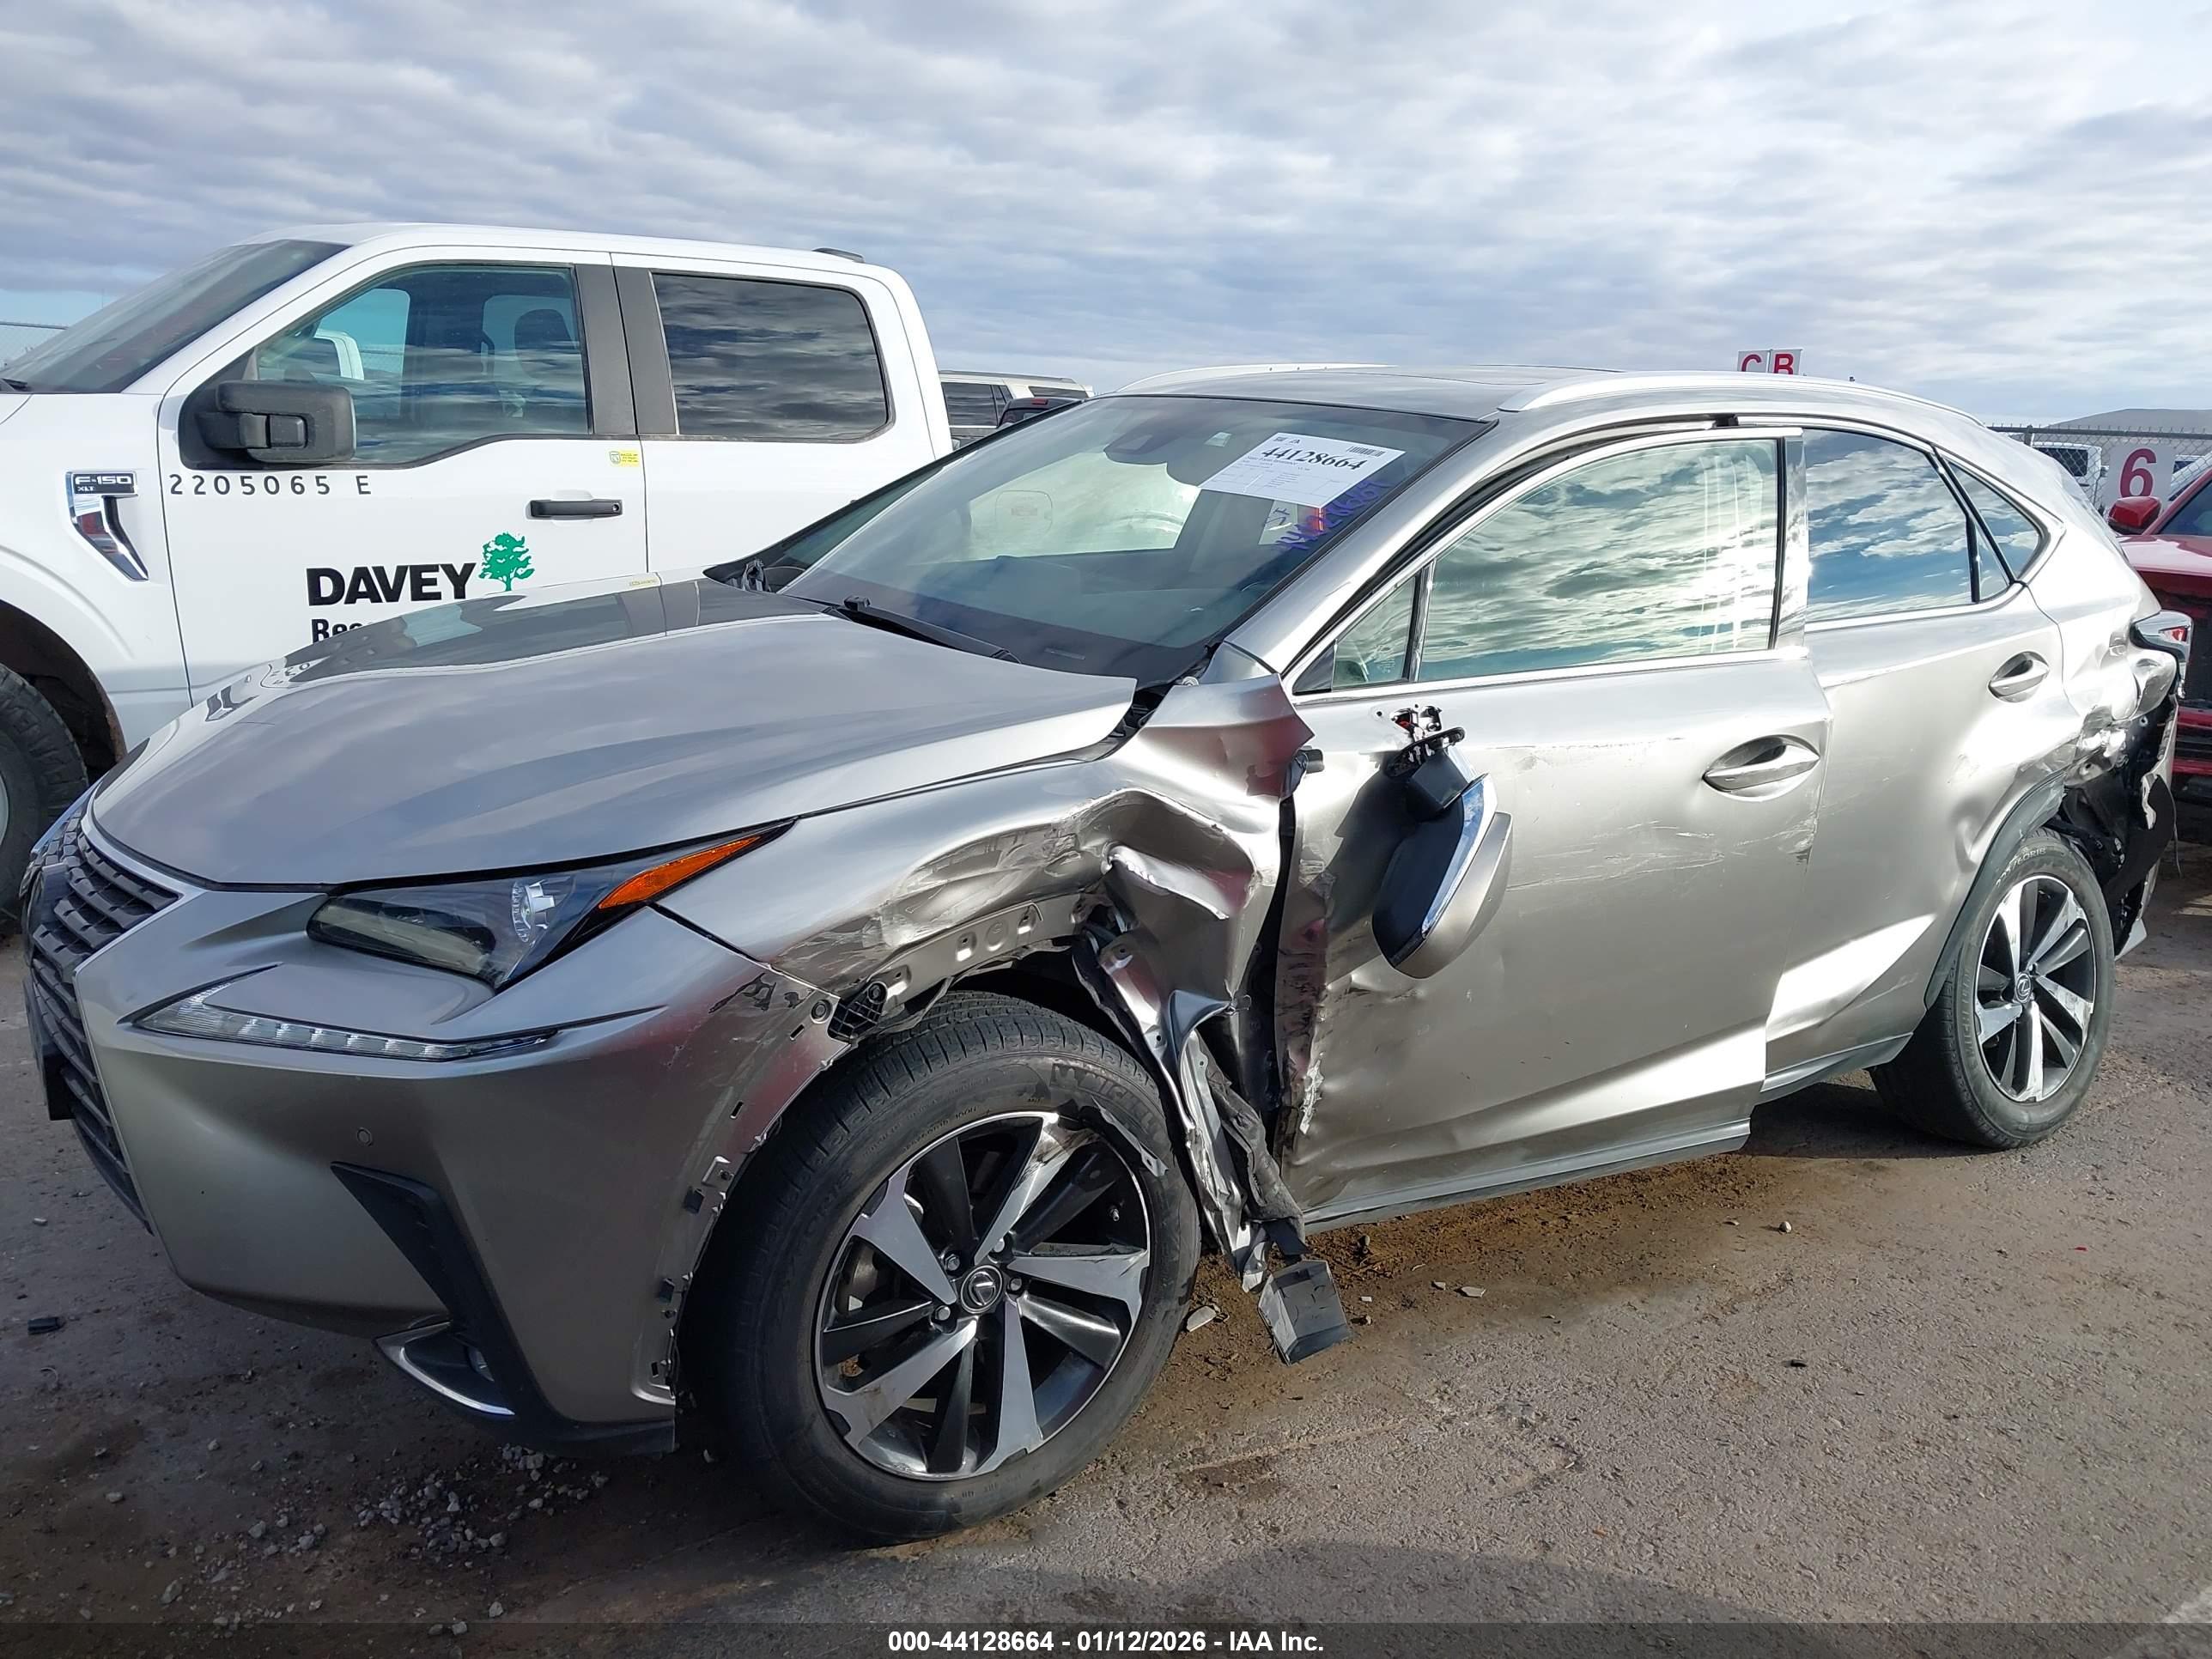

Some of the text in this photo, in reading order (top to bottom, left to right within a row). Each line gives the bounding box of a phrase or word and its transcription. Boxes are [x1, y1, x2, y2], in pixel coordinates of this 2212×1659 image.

[1261, 447, 1368, 470] 44128664
[75, 475, 132, 485] F-150
[169, 473, 372, 495] 2205065 E
[2119, 447, 2157, 498] 6
[306, 562, 477, 606] DAVEY
